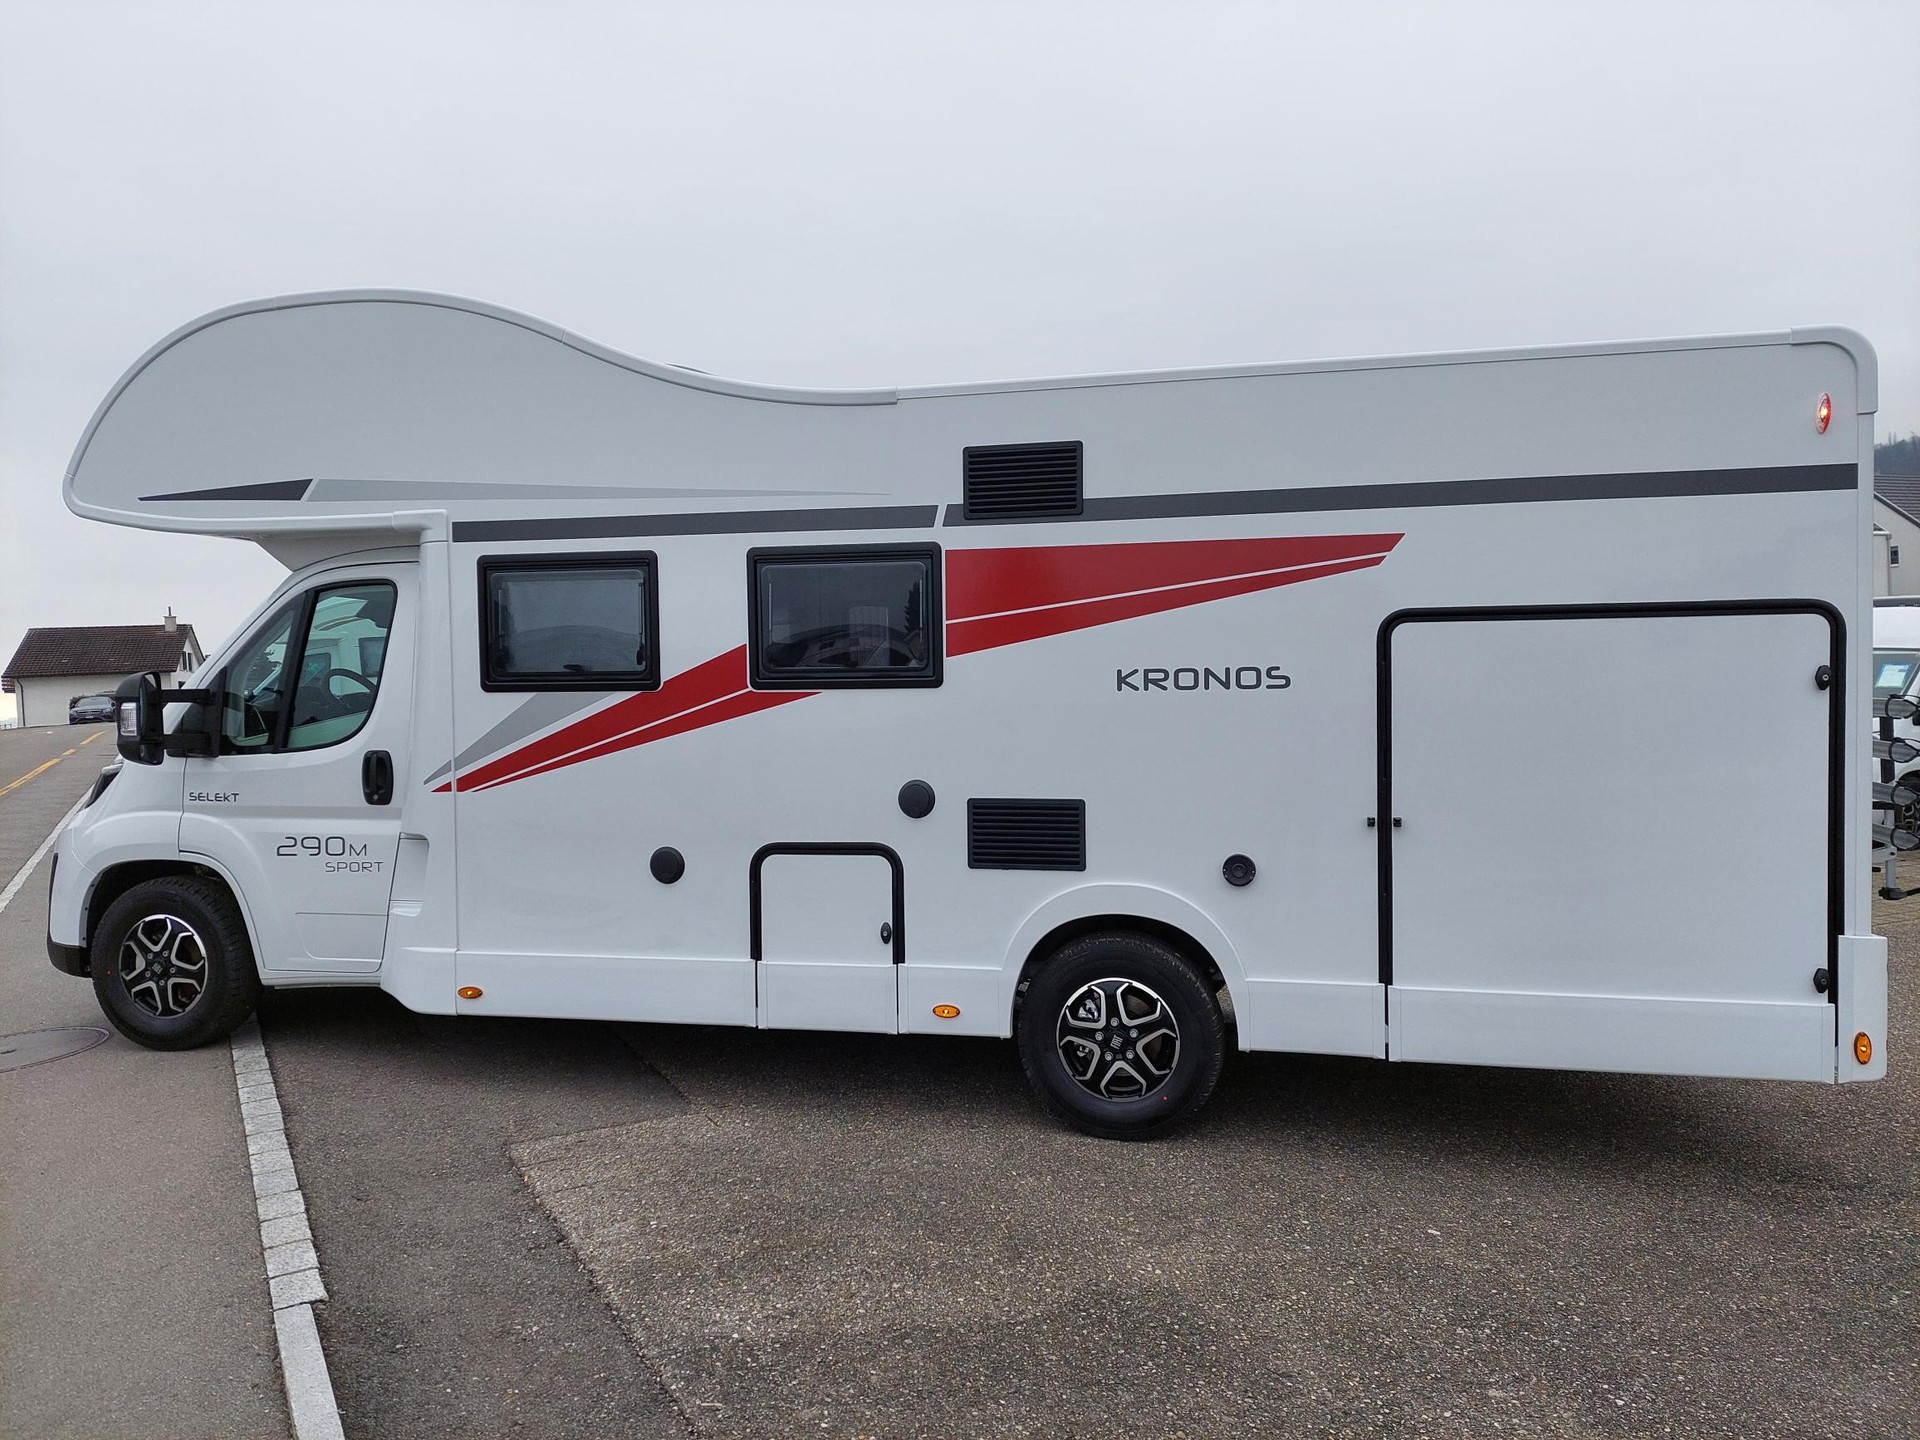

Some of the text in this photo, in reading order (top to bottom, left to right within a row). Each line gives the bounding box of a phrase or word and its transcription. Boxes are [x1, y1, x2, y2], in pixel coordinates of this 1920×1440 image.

[1116, 665, 1292, 692] KRONOS
[188, 791, 240, 803] SELEKT
[325, 861, 384, 873] SPORT
